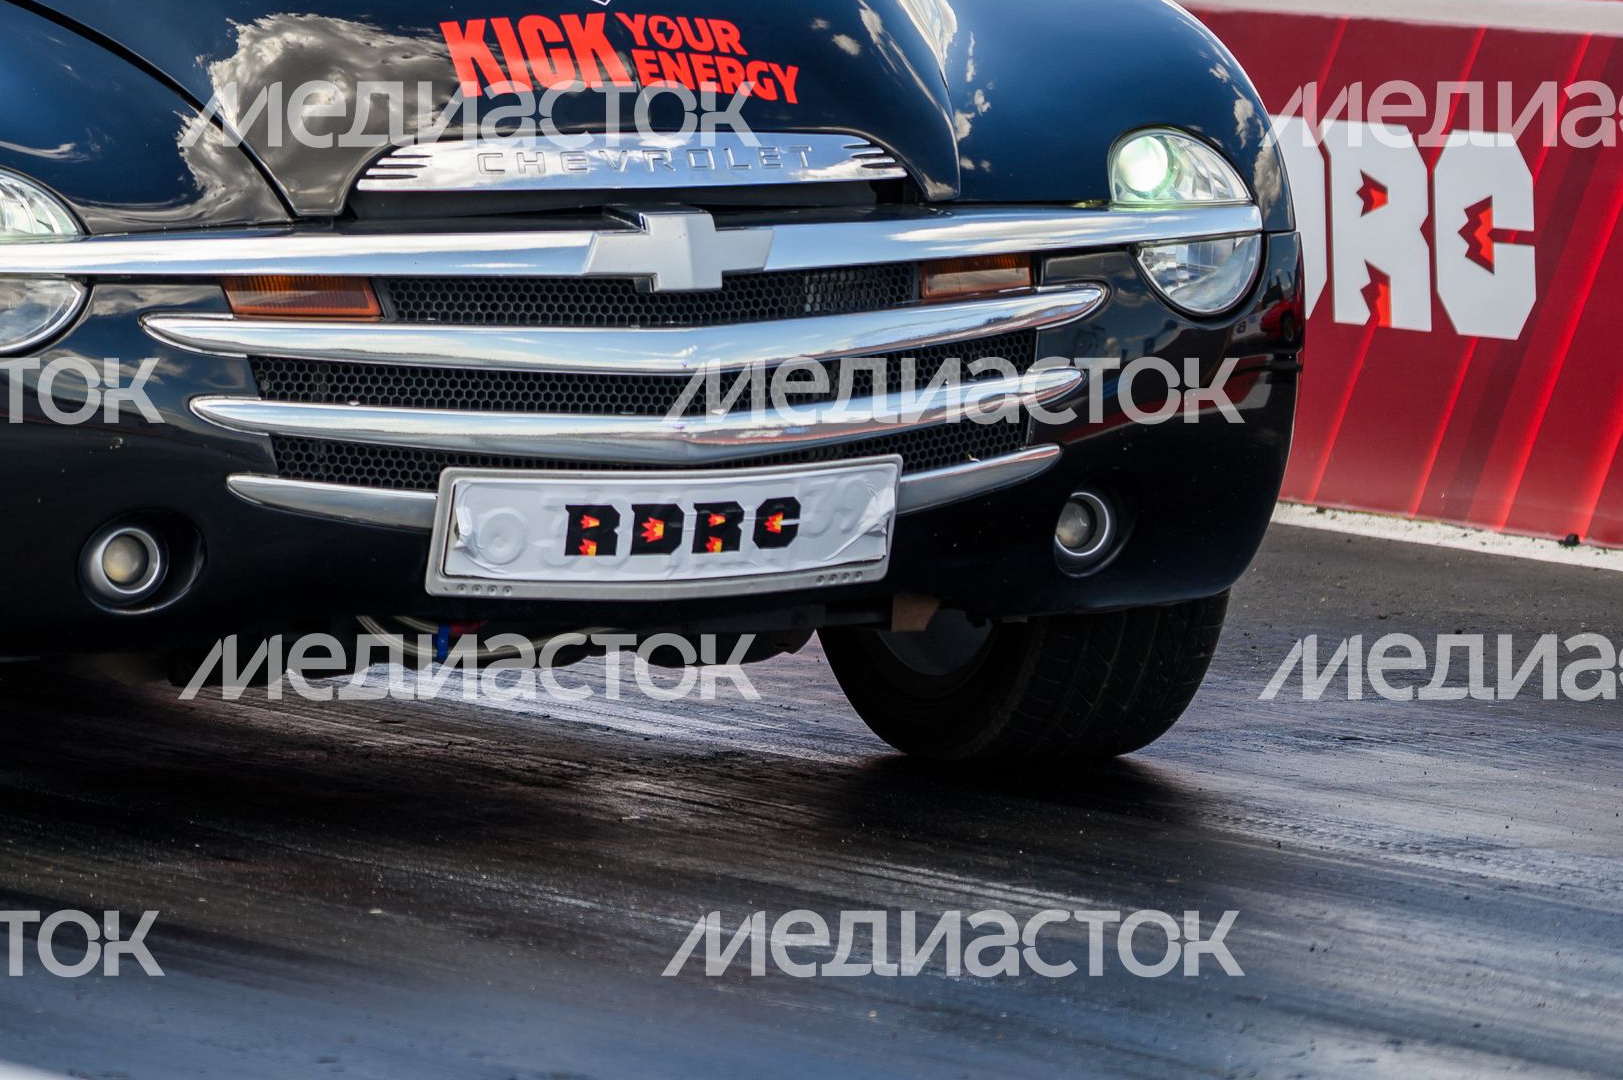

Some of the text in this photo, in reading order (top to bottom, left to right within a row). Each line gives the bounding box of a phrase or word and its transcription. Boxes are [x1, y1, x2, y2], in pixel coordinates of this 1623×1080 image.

[440, 11, 748, 99] KICK YOUR
[629, 49, 799, 105] ENERGY
[477, 145, 813, 176] CHEVROLET
[564, 496, 801, 557] RDRC
